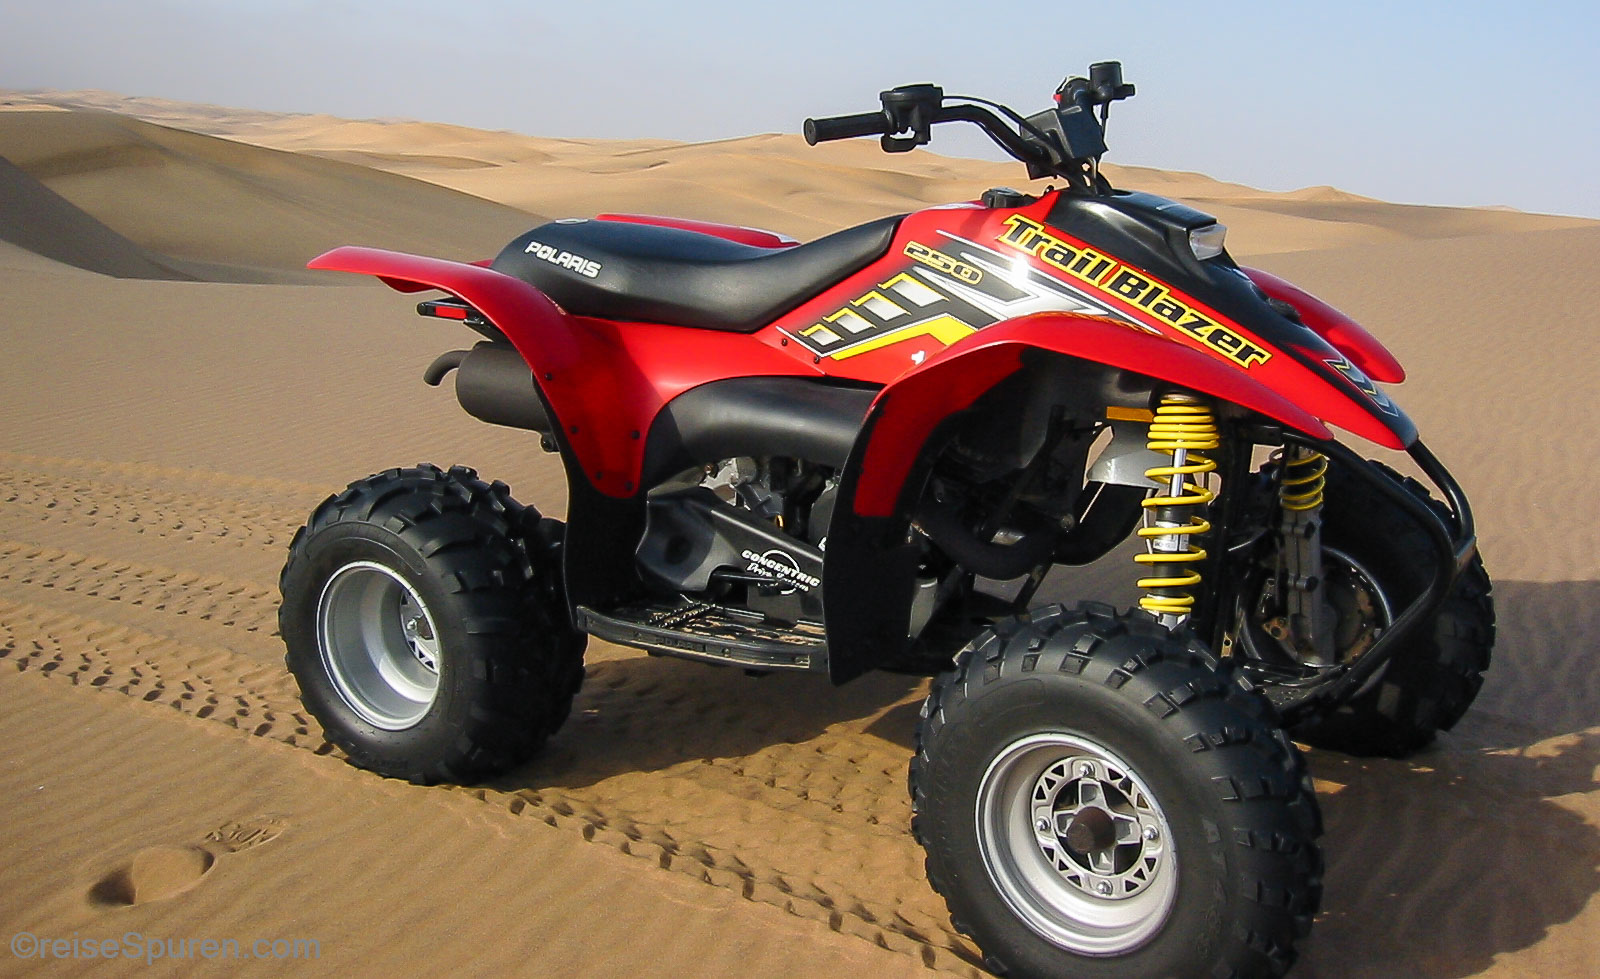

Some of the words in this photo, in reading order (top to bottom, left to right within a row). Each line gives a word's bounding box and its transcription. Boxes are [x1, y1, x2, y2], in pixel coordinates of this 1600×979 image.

[524, 241, 602, 278] POLARIS
[904, 241, 983, 285] 250
[999, 214, 1118, 287] Trail
[1100, 265, 1273, 368] Blazer
[741, 549, 821, 587] CONCENTRIC
